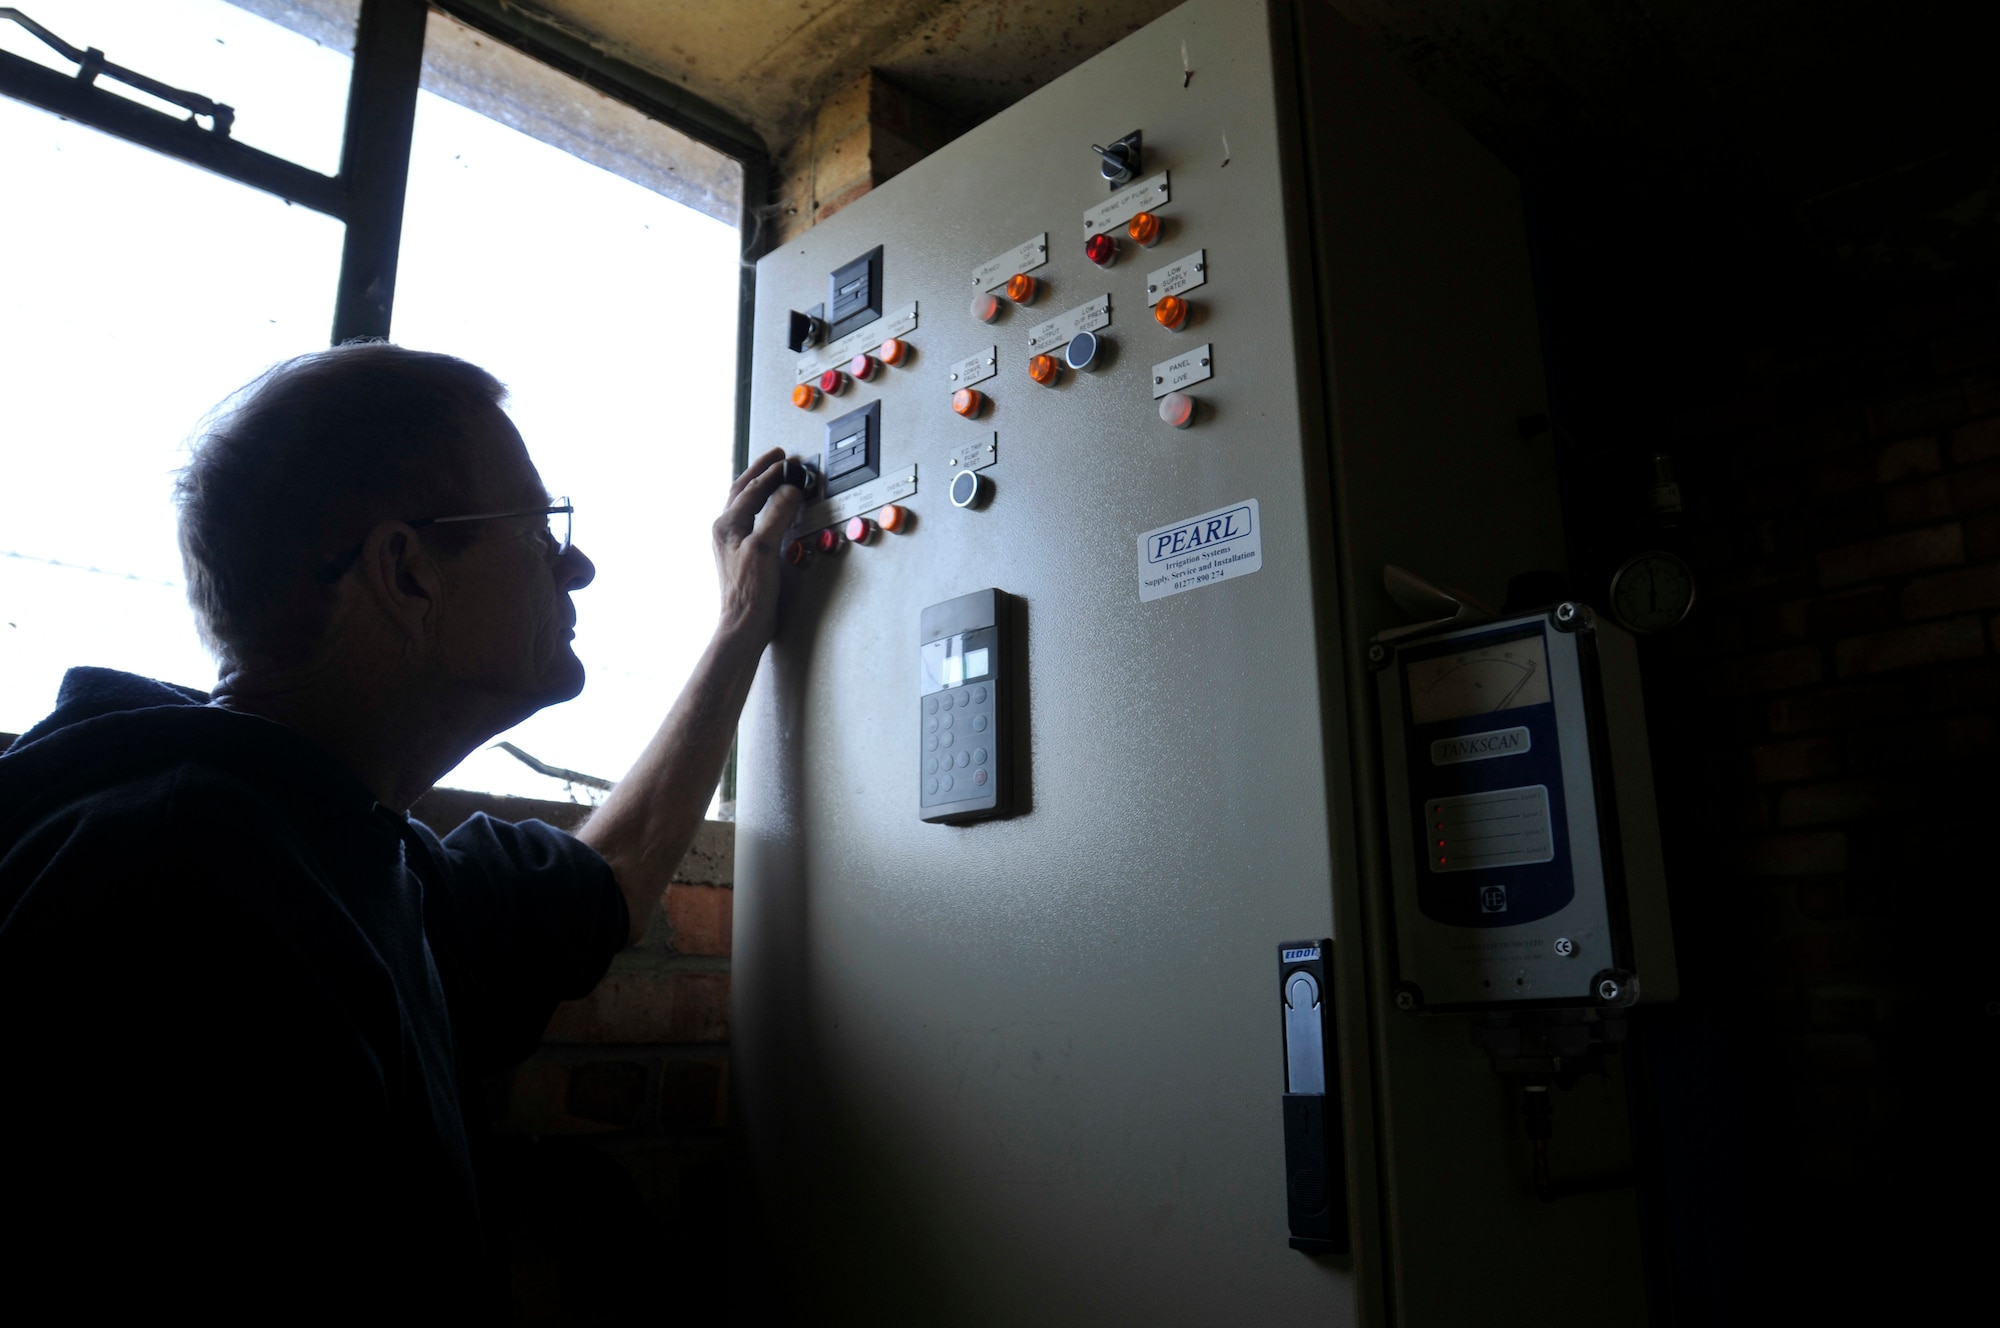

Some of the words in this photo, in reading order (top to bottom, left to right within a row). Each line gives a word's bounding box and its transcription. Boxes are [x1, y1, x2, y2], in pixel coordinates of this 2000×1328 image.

[1162, 271, 1188, 287] SUPPLY
[1167, 266, 1182, 277] LOW
[1164, 279, 1187, 293] WATER
[1081, 304, 1095, 315] LOW
[1042, 322, 1054, 334] LOW
[1034, 335, 1063, 351] PRESSURE
[1169, 359, 1191, 372] PANEL
[1173, 373, 1188, 384] LIVE
[1154, 514, 1239, 560] PEARL
[1166, 554, 1200, 571] Irrigation
[1200, 546, 1232, 561] Systems
[1171, 567, 1197, 579] Service
[1198, 560, 1212, 572] and
[1213, 551, 1256, 568] Installation
[1174, 577, 1195, 590] 01277
[1196, 573, 1210, 584] 890
[1211, 569, 1225, 580] 274
[1440, 732, 1521, 759] TANKSCAN
